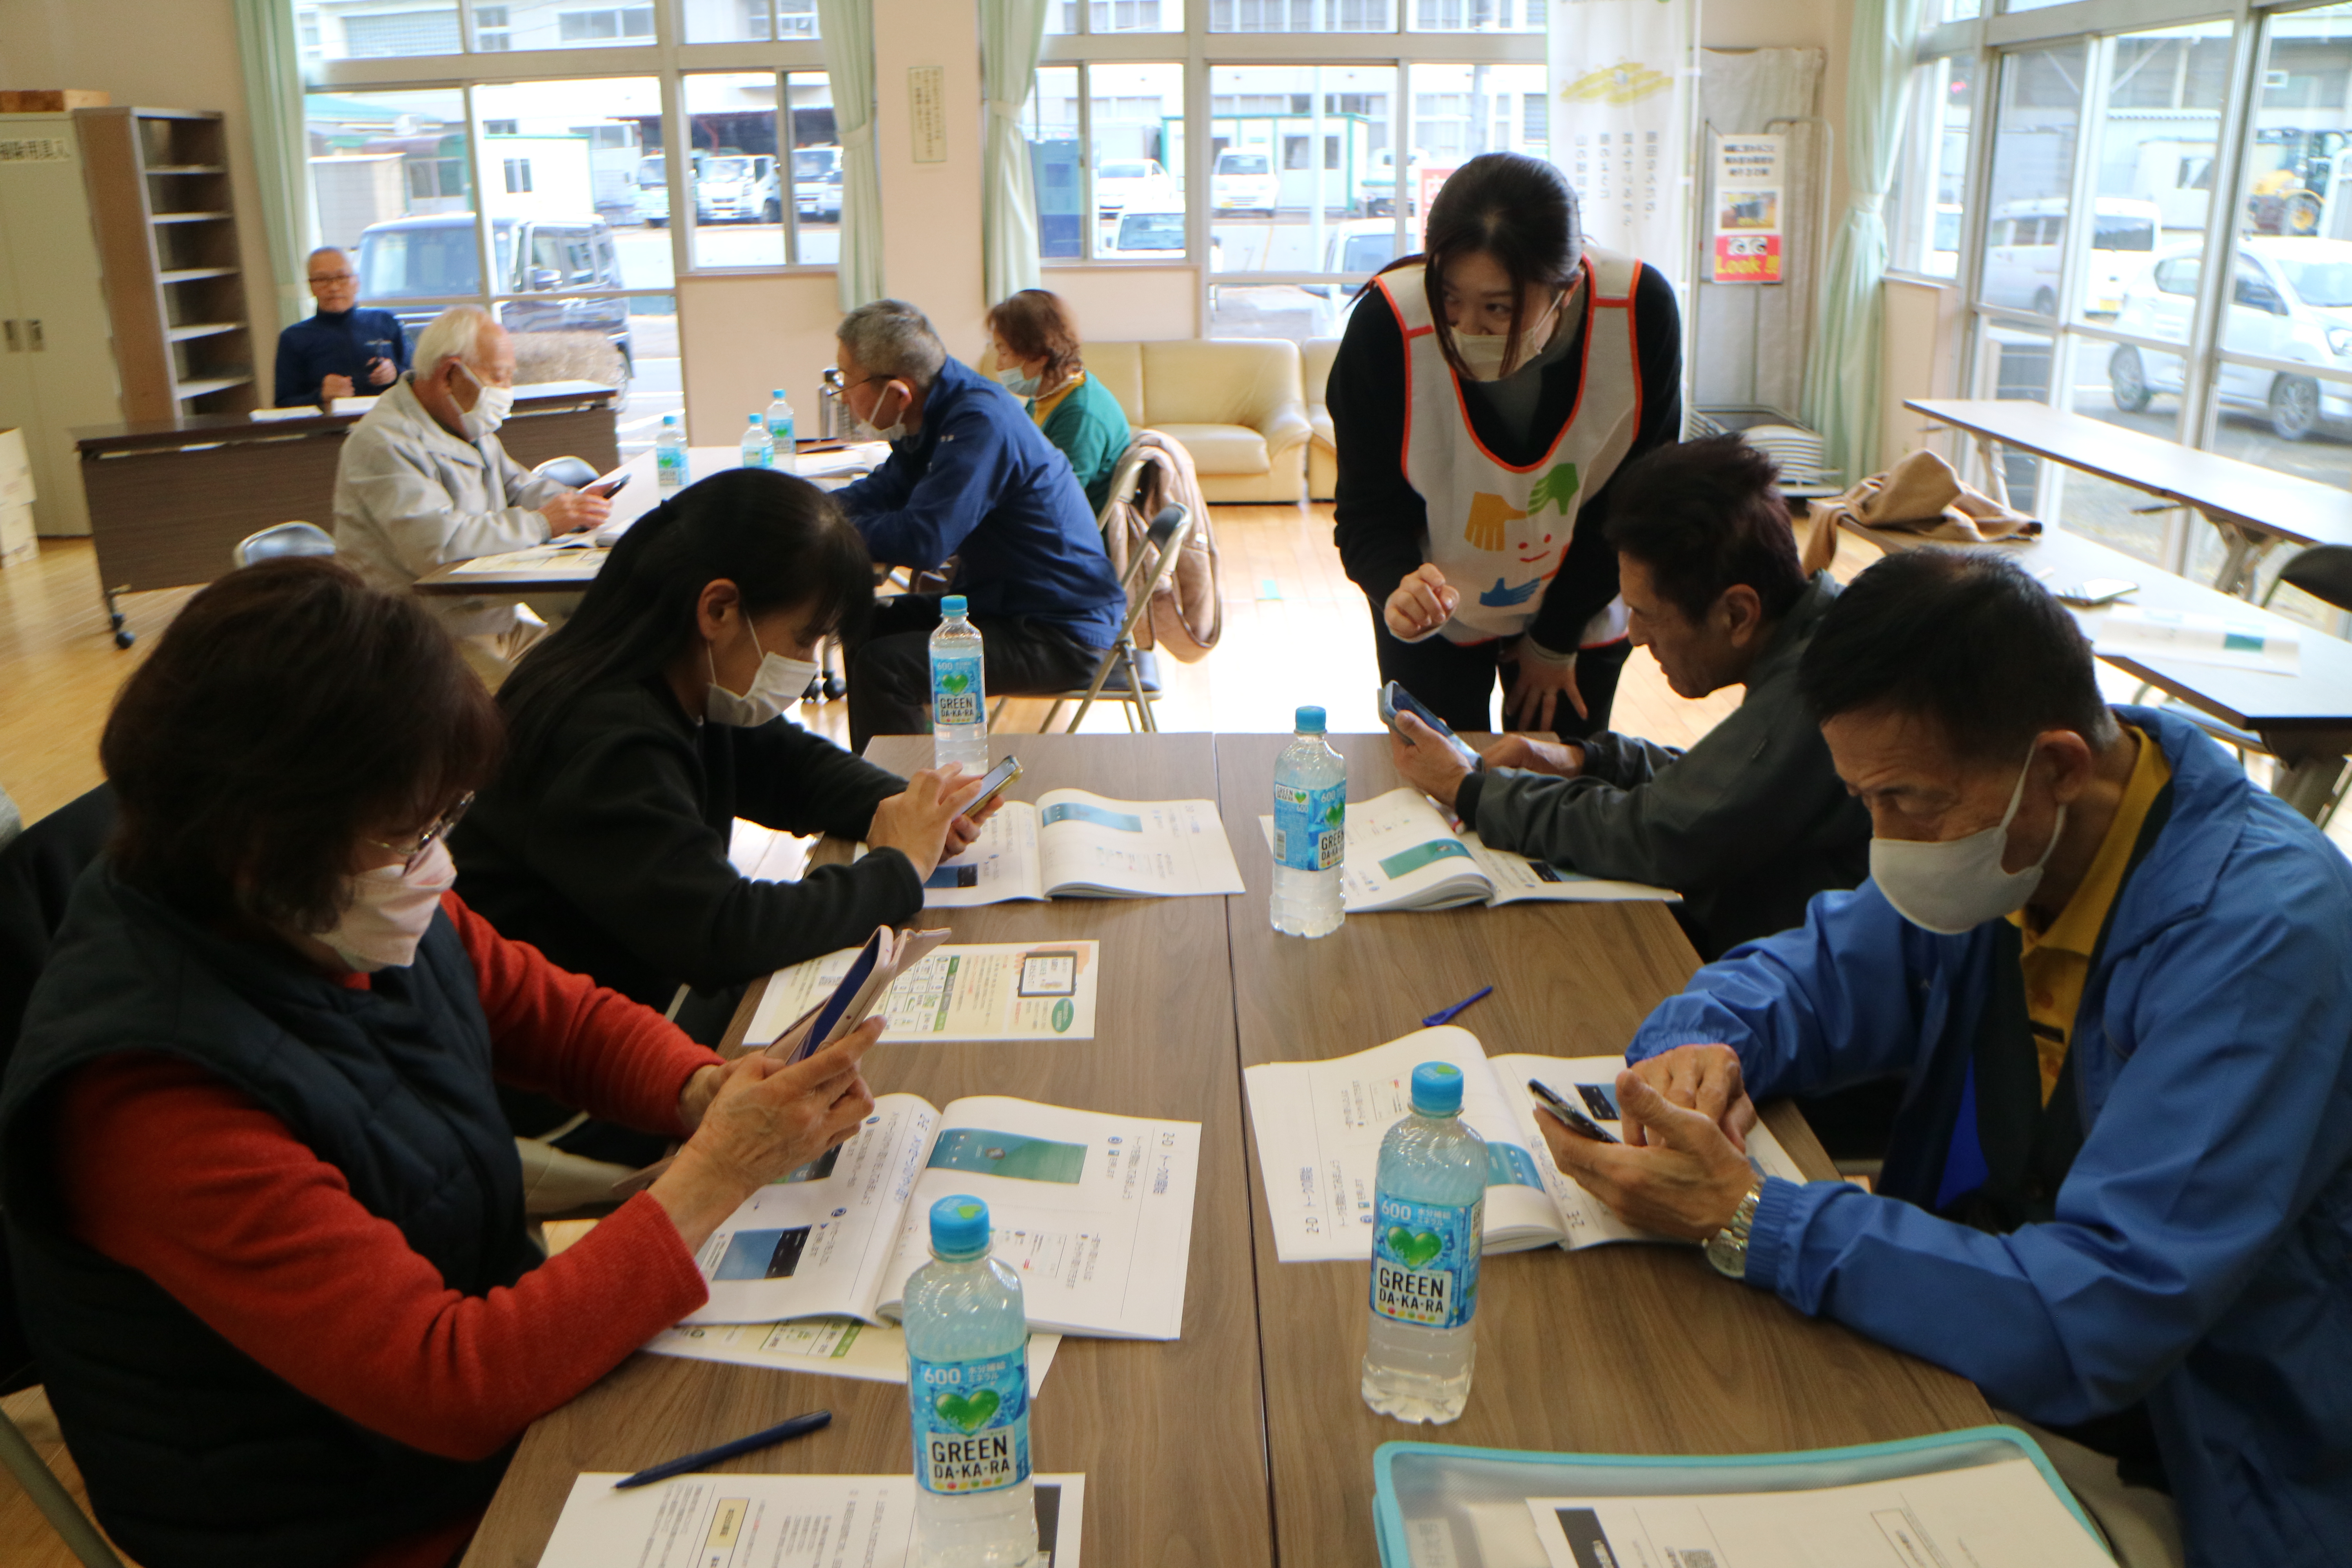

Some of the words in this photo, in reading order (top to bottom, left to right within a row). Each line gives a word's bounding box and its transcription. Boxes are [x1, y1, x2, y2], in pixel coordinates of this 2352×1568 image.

[1715, 255, 1761, 274] Look
[937, 662, 953, 670] 600
[940, 697, 973, 709] GREEN
[1321, 790, 1336, 803] 600
[1381, 1200, 1412, 1220] 600
[1306, 1217, 1319, 1234] 2-D
[1380, 1267, 1445, 1298] GREEN
[924, 1368, 961, 1385] 600
[933, 1434, 1007, 1463] GREEN
